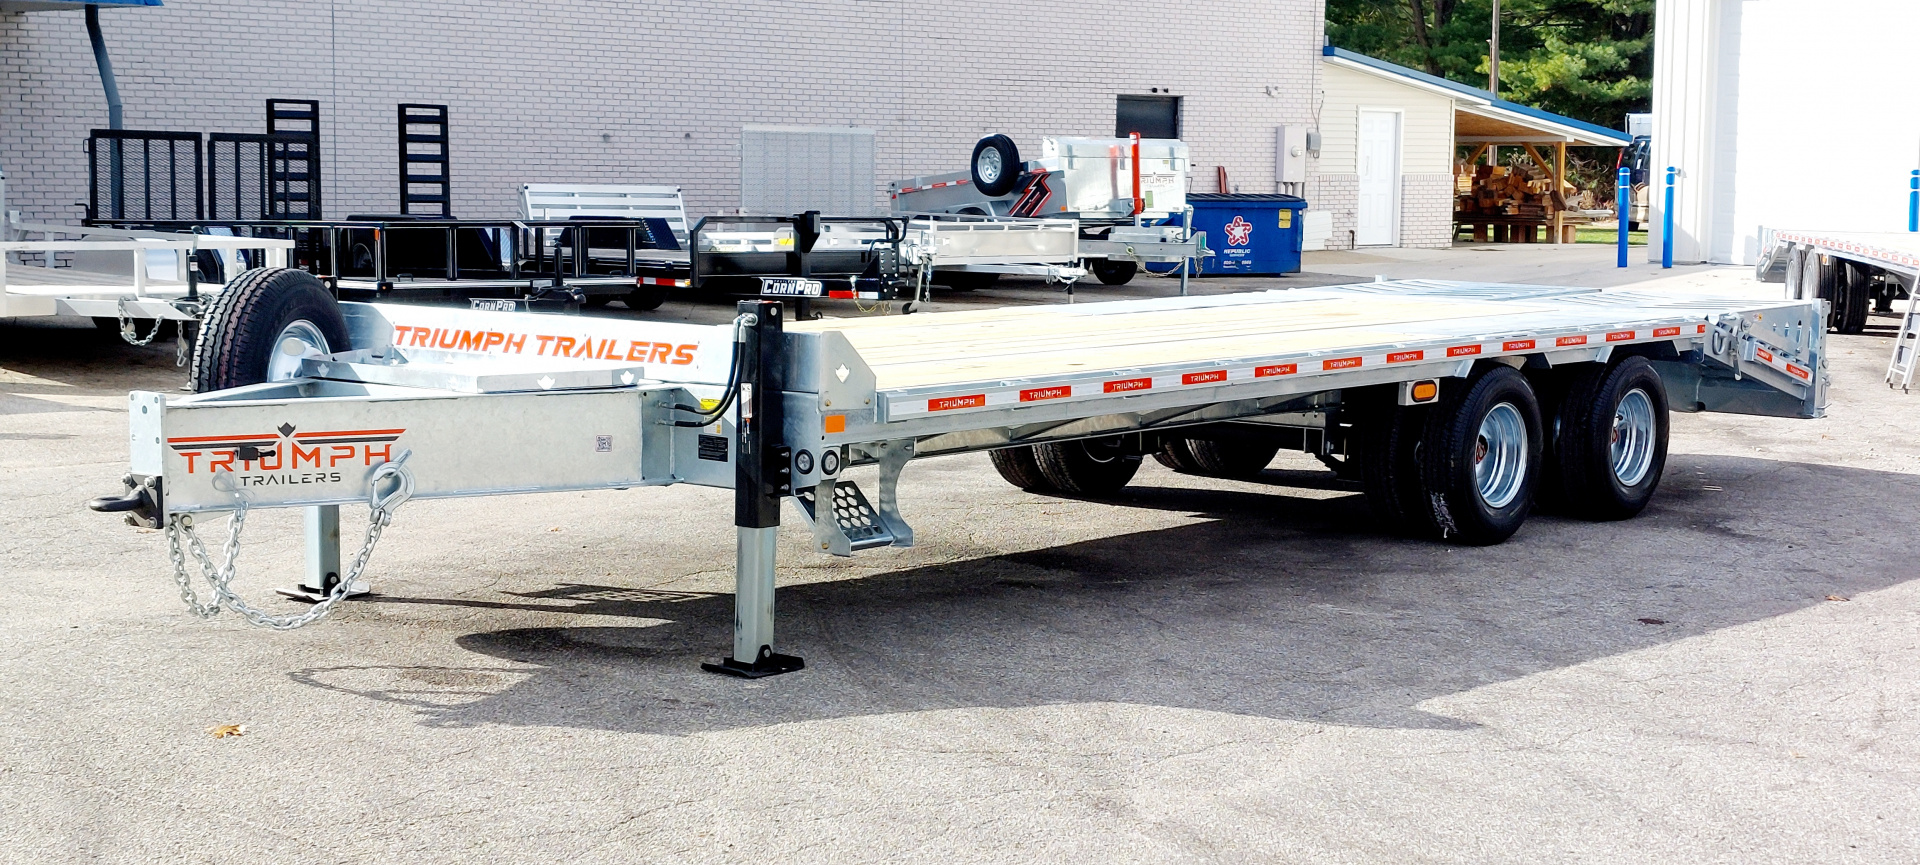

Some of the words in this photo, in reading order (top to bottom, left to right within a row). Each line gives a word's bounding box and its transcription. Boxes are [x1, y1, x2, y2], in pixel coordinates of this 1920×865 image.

[394, 325, 528, 355] TRIUMPH
[536, 334, 699, 366] TRAILERS
[1393, 353, 1417, 361] TRIUMPH
[1330, 359, 1356, 368] TRIUMPH
[1263, 366, 1290, 375] TRIUMPH
[1190, 373, 1219, 382] TRIUMPH
[1112, 381, 1144, 390] TRIUMPH
[1029, 389, 1062, 399] TRIUMPH
[939, 398, 975, 408] TRIUMPH
[240, 472, 342, 487] TRAILERS
